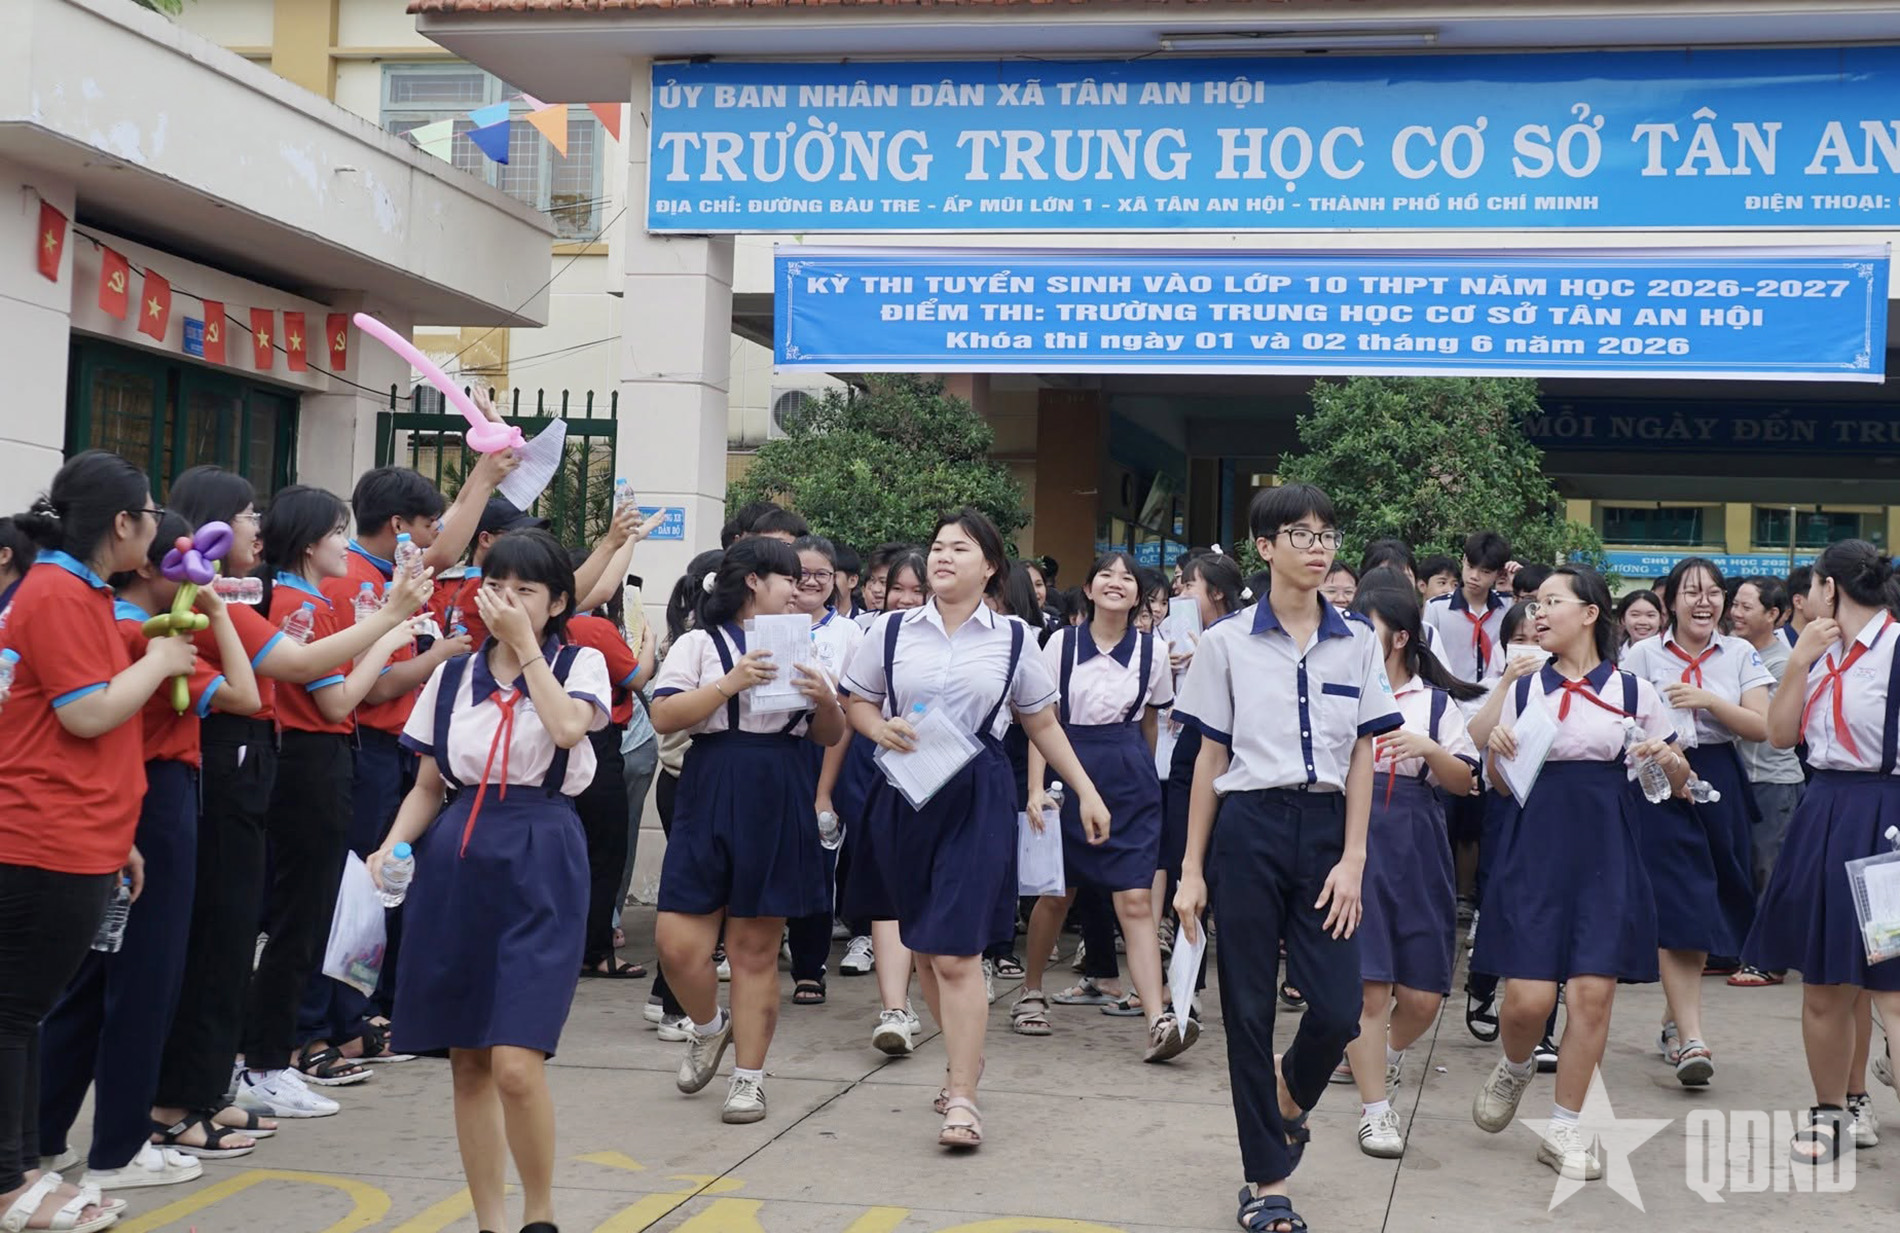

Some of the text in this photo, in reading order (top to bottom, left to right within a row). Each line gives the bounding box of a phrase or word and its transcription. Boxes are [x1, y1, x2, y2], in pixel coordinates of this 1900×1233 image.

[659, 76, 1264, 109] ỦY BAN NHÂN DÂN XÃ TÂN AN HỘI
[658, 102, 1900, 193] TRƯỜNG TRUNG HỌC CƠ SỞ TÂN AN
[655, 199, 692, 216] ĐỊA
[698, 195, 741, 213] CHỈ:
[747, 196, 823, 213] ĐƯỜNG
[829, 196, 874, 213] BÀU
[880, 199, 921, 213] TRE
[942, 194, 974, 213] ẤP
[981, 196, 1023, 213] MŨI
[1030, 196, 1074, 213] LỚN
[1082, 198, 1092, 212] 1
[1117, 195, 1148, 212] XÃ
[1154, 195, 1200, 212] TÂN
[1206, 198, 1239, 212] AN
[1246, 195, 1285, 214] HỘI
[1308, 194, 1386, 211] THÀNH
[1392, 192, 1440, 211] PHỐ
[1447, 192, 1480, 211] HỒ
[1486, 193, 1527, 211] CHÍ
[1534, 196, 1599, 210] MINH
[1745, 193, 1803, 213] ĐIỆN
[1811, 194, 1891, 212] THOẠI:
[807, 269, 1850, 300] KỲ THI TUYỂN SINH VÀO LỚP 10 THPT NĂM HỌC 2026-2027
[880, 297, 1763, 330] ĐIỂM THI: TRƯỜNG TRUNG HỌC CƠ SỞ TÂN AN HỘI
[946, 331, 1690, 356] Khóa thi ngày 01 và 02 tháng 6 năm 2026
[1609, 411, 1719, 440] NGÀY
[1732, 408, 1819, 442] ĐẾN
